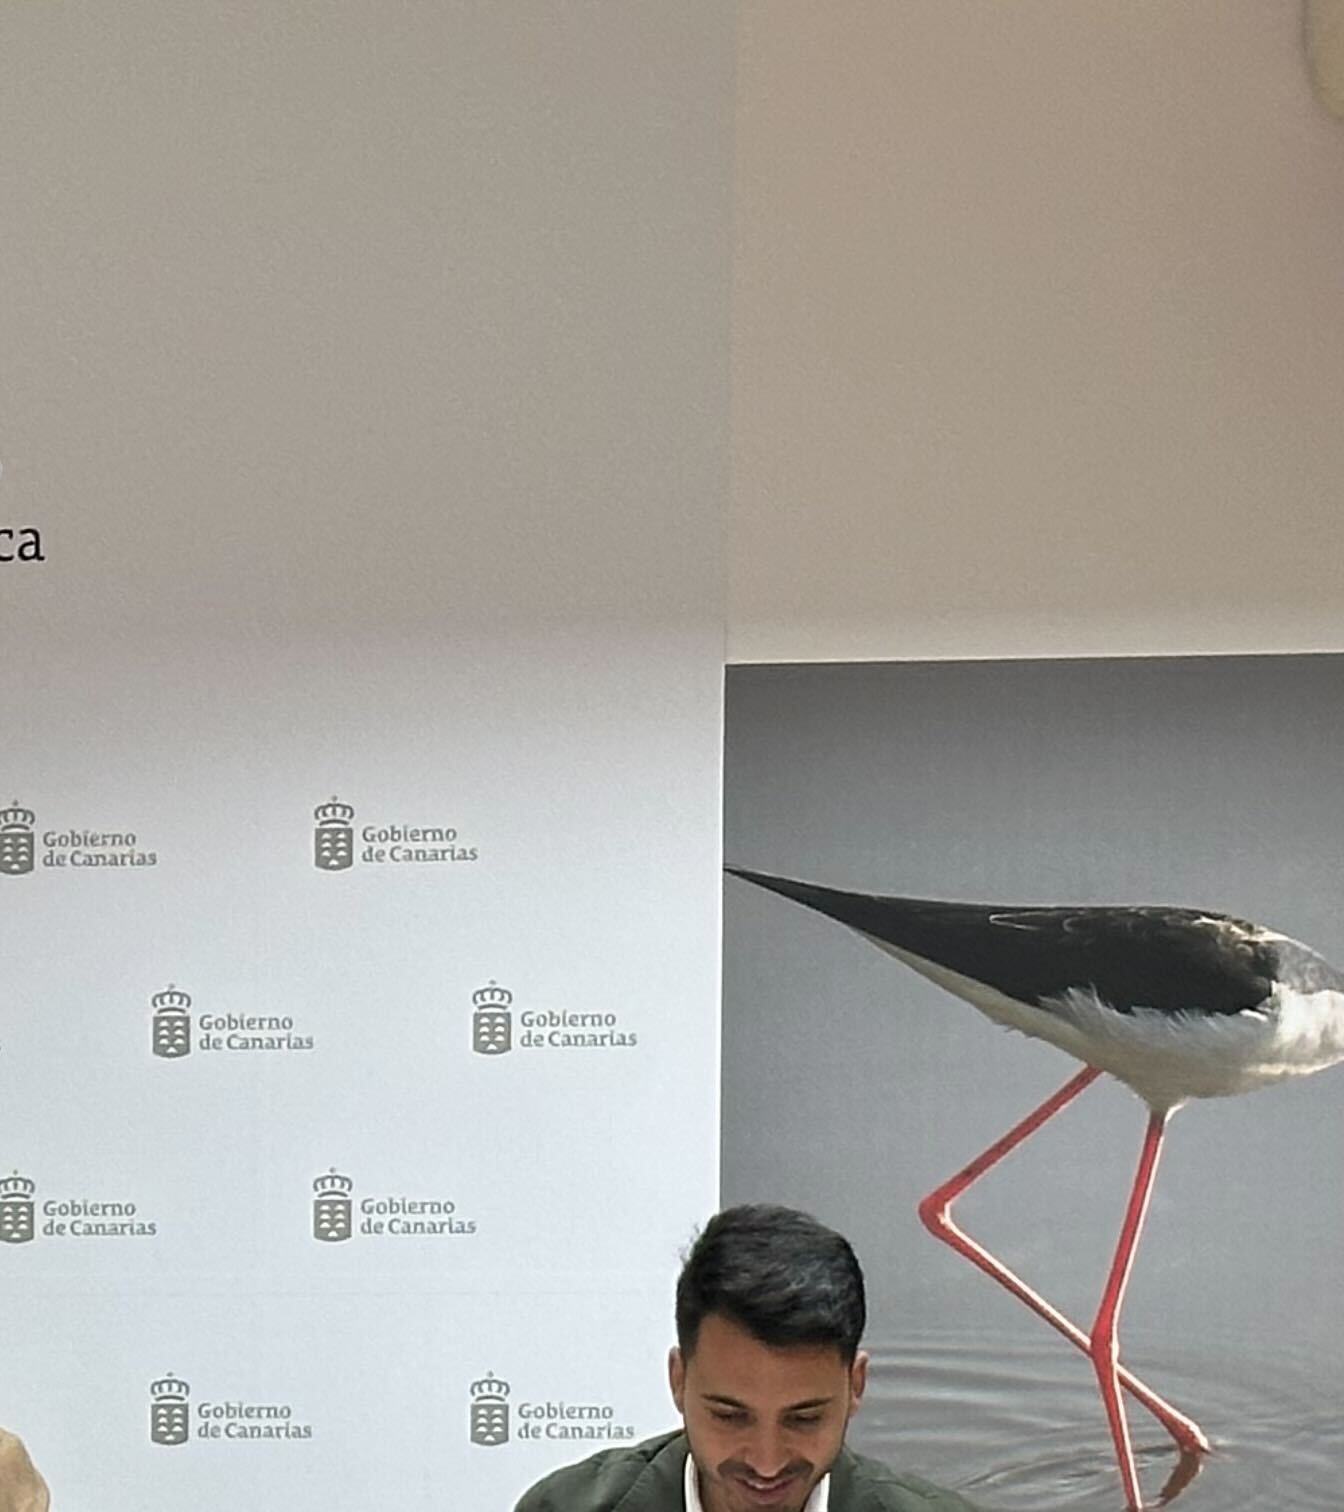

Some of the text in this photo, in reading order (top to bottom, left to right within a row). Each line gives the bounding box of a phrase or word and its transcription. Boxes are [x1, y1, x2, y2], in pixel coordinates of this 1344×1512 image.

[42, 829, 137, 848] Gobierno
[361, 824, 458, 844] Gobierno
[42, 849, 158, 868] de Canarias
[361, 844, 479, 863] de Canarias
[199, 1012, 294, 1031] Gobierno
[520, 1009, 617, 1028] Gobierno
[198, 1032, 314, 1051] de Canarias
[519, 1029, 638, 1048] de Canarias
[42, 1199, 137, 1217] Gobierno
[360, 1197, 456, 1215] Gobierno
[42, 1218, 157, 1237] de Canarias
[360, 1216, 477, 1235] de Canarias
[197, 1401, 292, 1420] Gobierno
[517, 1401, 614, 1420] Gobierno
[197, 1421, 313, 1440] de Canarias
[517, 1421, 635, 1440] de Canarias
